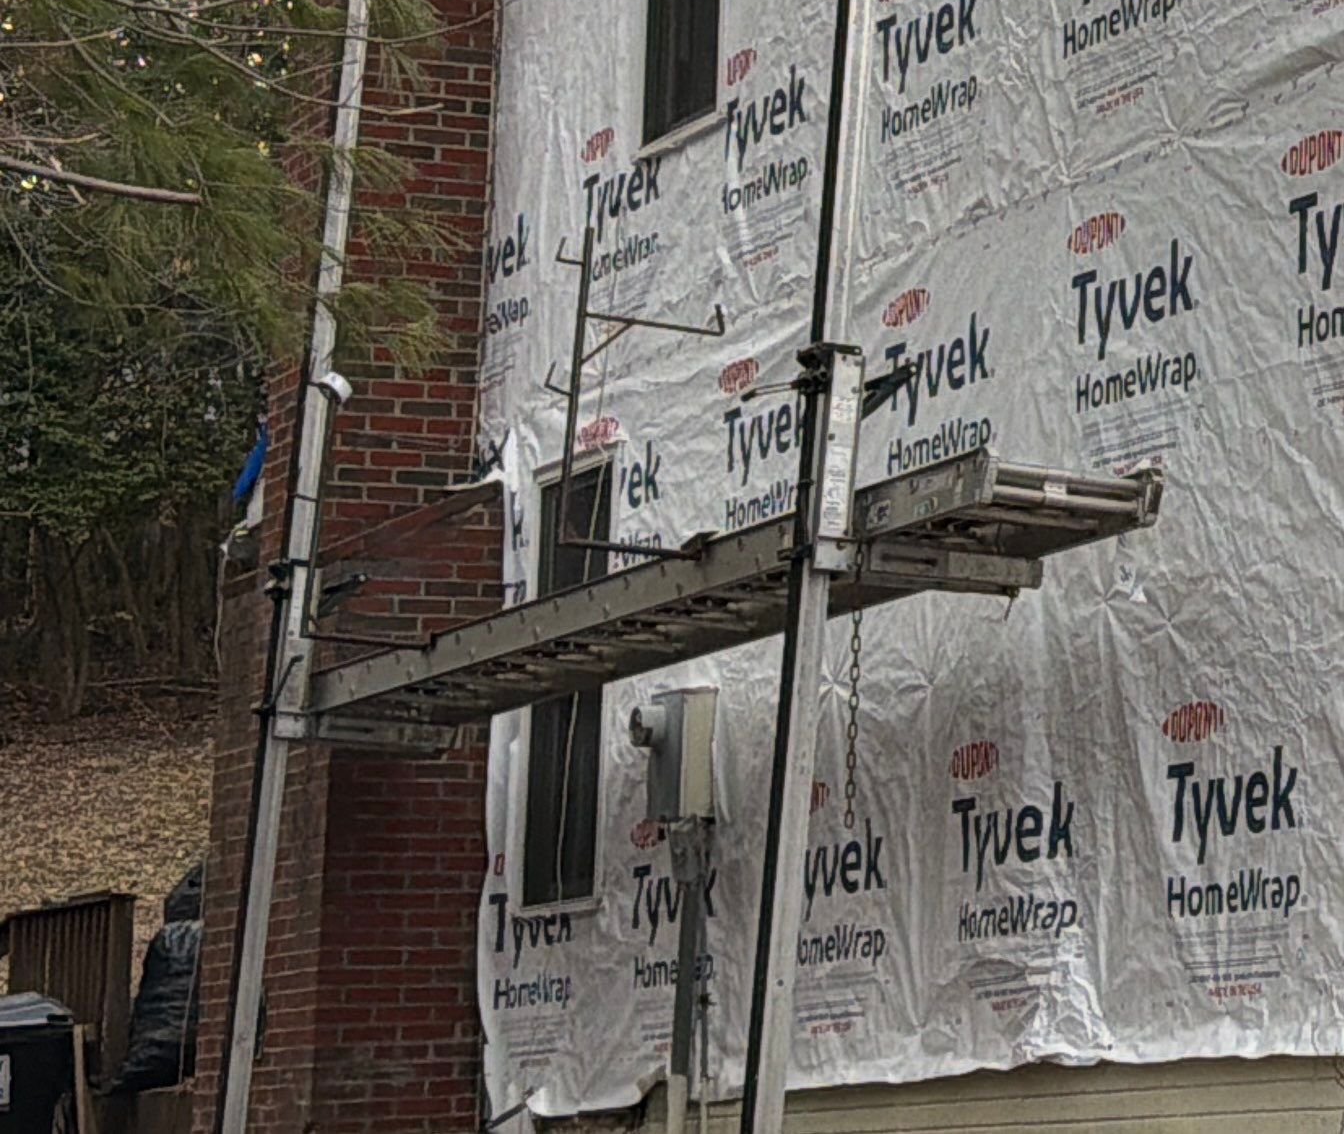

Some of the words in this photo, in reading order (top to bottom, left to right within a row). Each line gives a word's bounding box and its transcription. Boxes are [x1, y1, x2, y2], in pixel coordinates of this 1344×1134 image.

[725, 64, 806, 173] Tyvek
[881, 74, 978, 144] HomeWrap
[1289, 130, 1343, 175] DUPONT
[486, 213, 530, 285] vek
[1075, 212, 1122, 255] DUPONT
[1072, 238, 1194, 360] Tyvek
[884, 312, 992, 427] Tyvek
[1075, 352, 1196, 414] HomeWrap
[887, 415, 993, 476] HomeWrap
[725, 481, 799, 531] HomeWr
[952, 780, 1075, 892] Tyvek
[1167, 745, 1299, 865] Tyvek
[957, 892, 1078, 943] HomeWrap
[1167, 868, 1300, 919] HomeWrap
[799, 923, 885, 967] omeWrap
